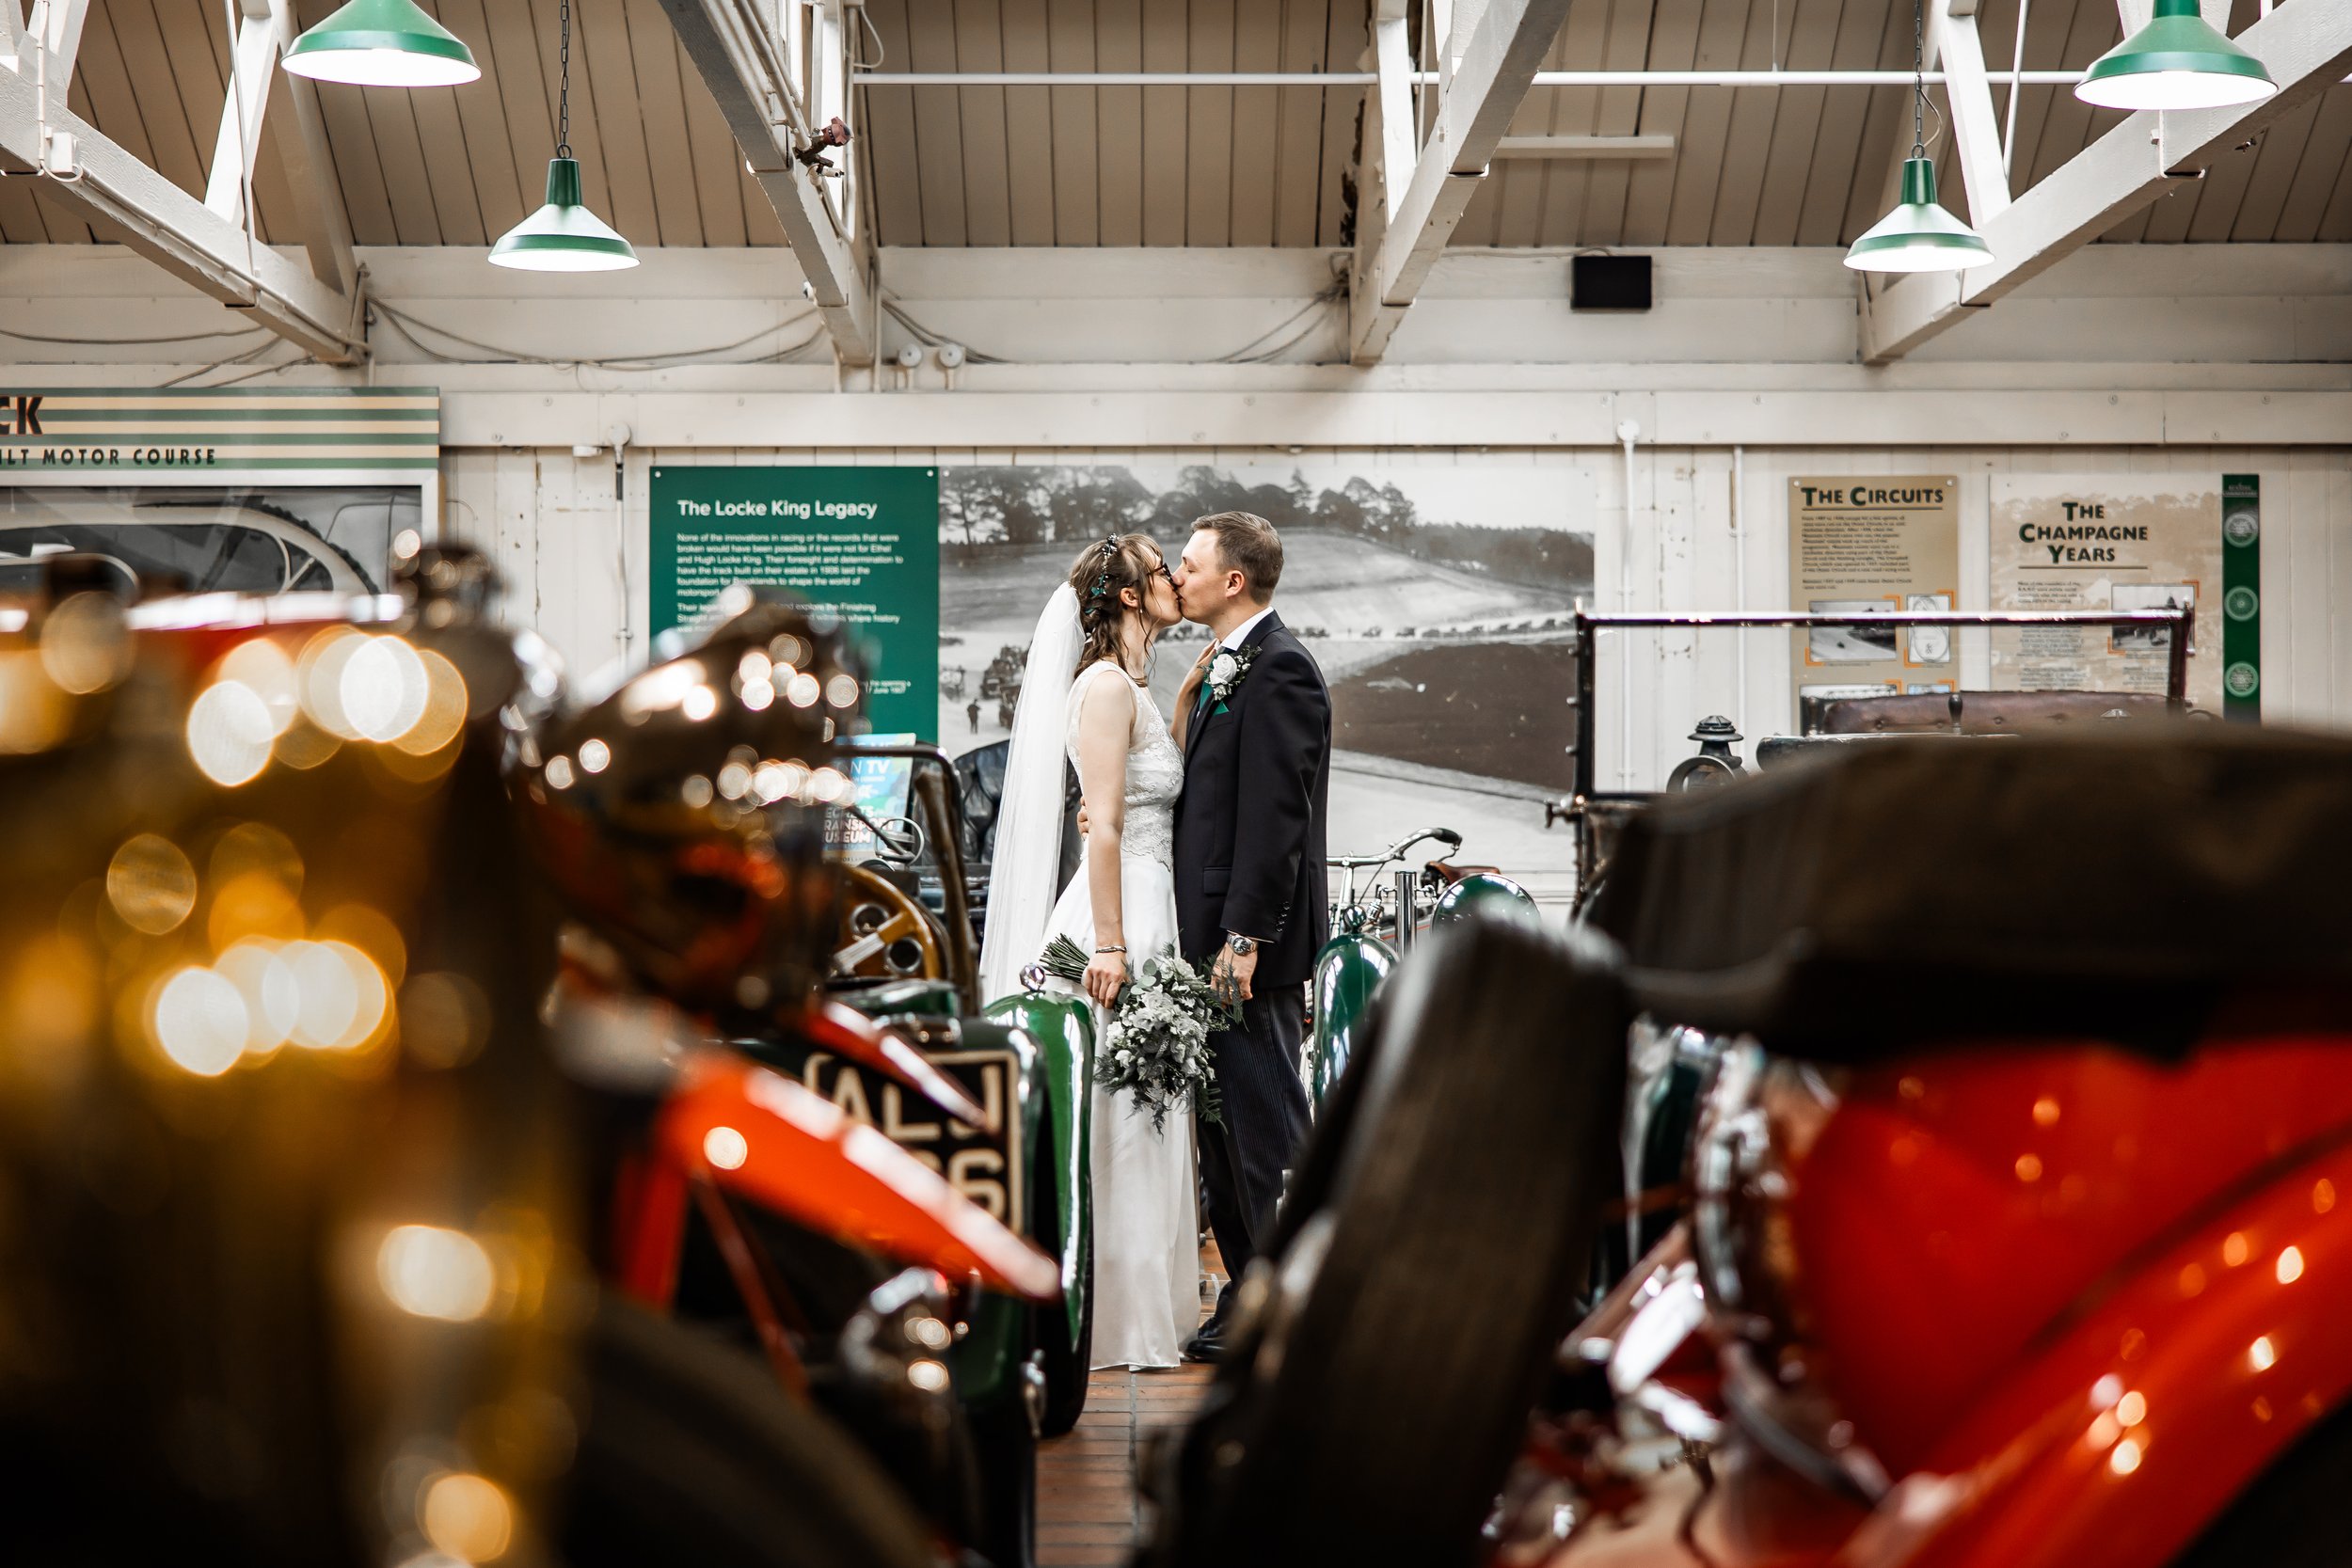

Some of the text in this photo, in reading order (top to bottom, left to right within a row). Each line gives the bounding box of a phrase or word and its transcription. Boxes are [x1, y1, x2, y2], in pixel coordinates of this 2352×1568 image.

[42, 449, 119, 465] MOTOR
[133, 449, 215, 465] COURSE
[677, 500, 877, 520] The Locke King Legacy
[700, 533, 709, 543] of
[710, 533, 723, 543] the
[724, 533, 770, 543] innovations
[781, 533, 805, 545] racing
[817, 533, 829, 543] the
[831, 533, 861, 543] records
[862, 533, 878, 543] that
[677, 544, 705, 553] broken
[706, 544, 730, 553] would
[732, 544, 751, 553] have
[753, 544, 773, 553] been
[774, 544, 807, 555] possible
[843, 544, 857, 553] not
[858, 544, 869, 553] for
[870, 544, 892, 553] Ethel
[677, 555, 693, 564] and
[694, 555, 716, 566] Hugh
[718, 555, 741, 564] Locke
[765, 555, 786, 564] Their
[787, 555, 821, 566] foresight
[823, 555, 838, 564] and
[840, 555, 894, 564] determination
[677, 566, 697, 576] have
[698, 566, 712, 576] the
[713, 566, 732, 576] track
[734, 566, 751, 576] built
[764, 566, 783, 576] their
[785, 566, 809, 576] estate
[857, 566, 870, 576] the
[677, 577, 719, 586] foundation
[788, 577, 814, 588] shape
[815, 577, 827, 586] the
[829, 577, 851, 586] world
[866, 759, 890, 774] TV
